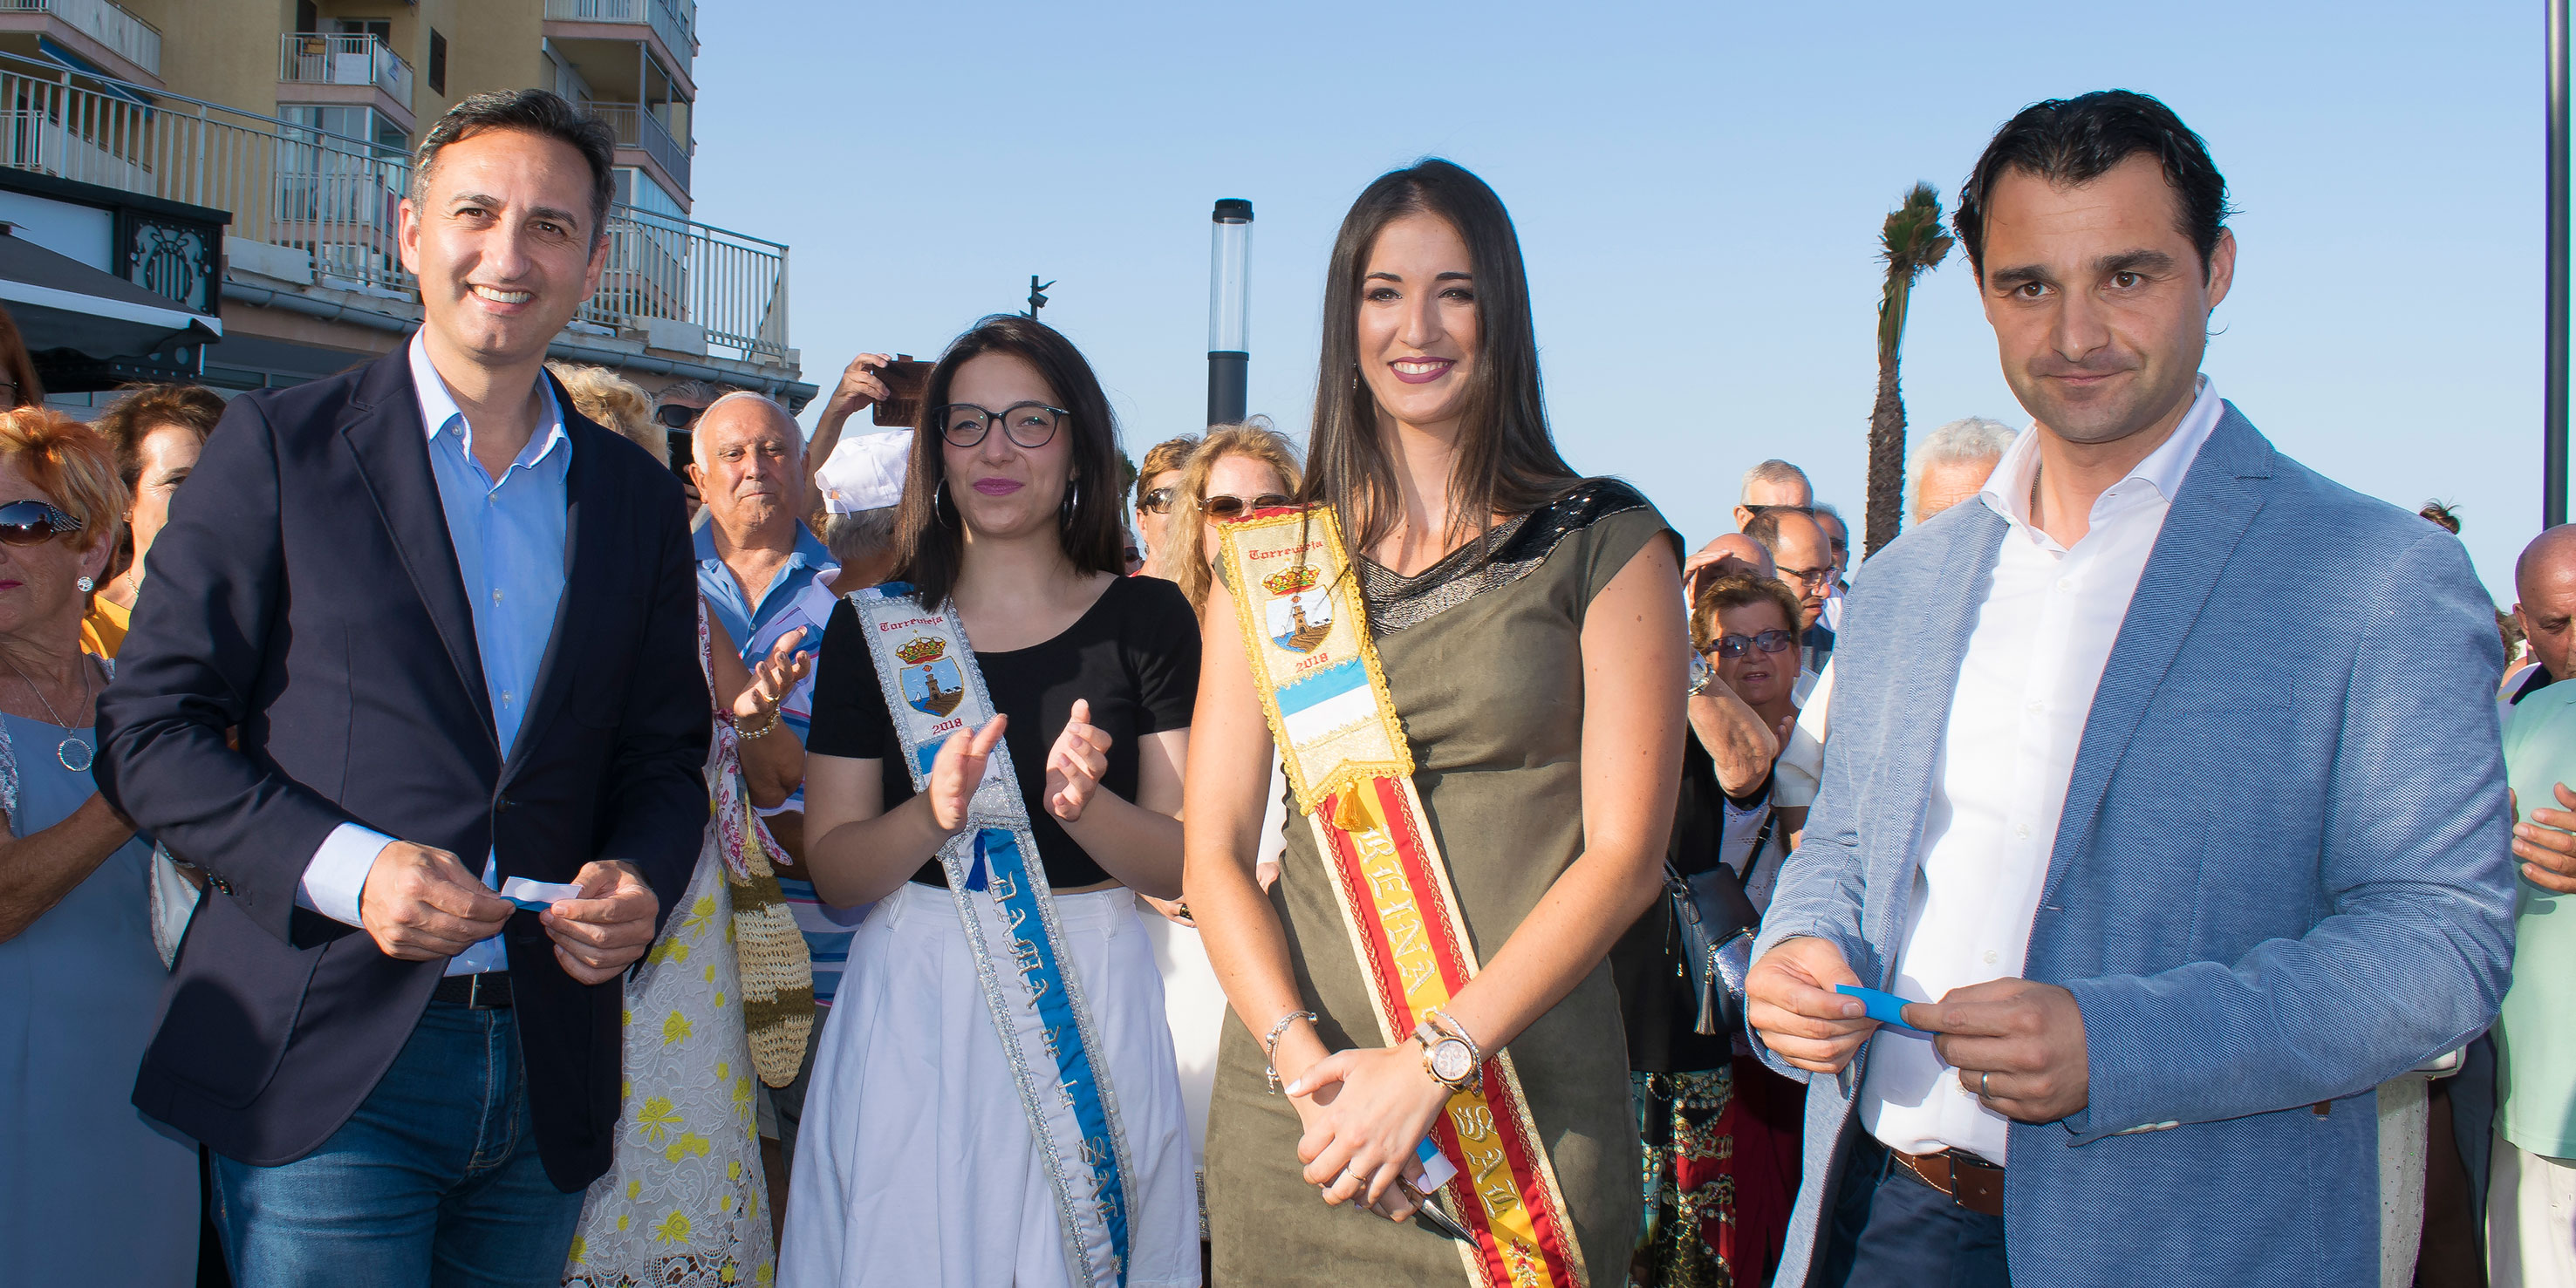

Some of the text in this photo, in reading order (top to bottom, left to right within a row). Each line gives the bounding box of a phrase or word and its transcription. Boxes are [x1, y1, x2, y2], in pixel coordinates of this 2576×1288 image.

[879, 616, 943, 632] Torrevieja
[1295, 652, 1329, 673] 2018
[932, 718, 963, 735] 2018
[1356, 822, 1522, 1220] REINA SAL
[988, 871, 1118, 1228] DAMA de la SAL
